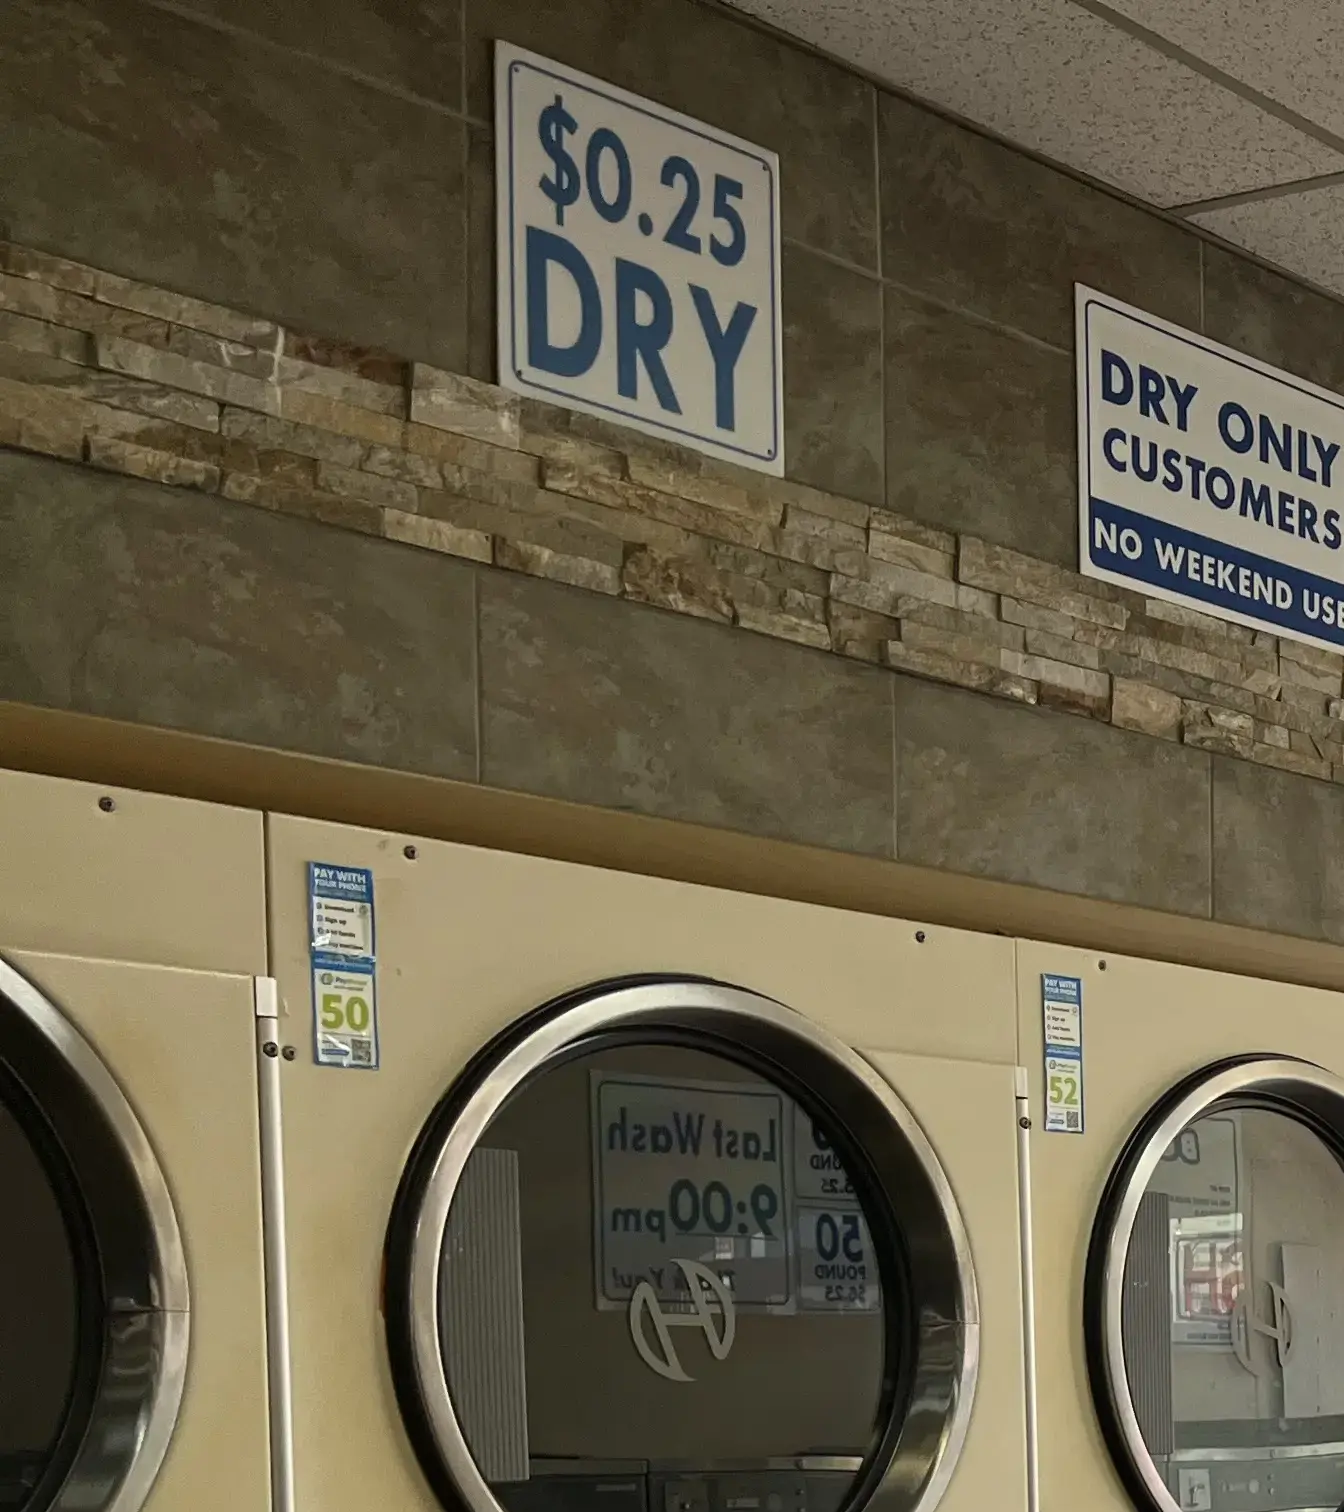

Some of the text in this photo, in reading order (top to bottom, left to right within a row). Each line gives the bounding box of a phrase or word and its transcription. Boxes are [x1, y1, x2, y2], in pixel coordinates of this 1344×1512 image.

[537, 95, 746, 267] $0.25
[525, 225, 758, 432] DRY
[1101, 350, 1341, 488] DRY ONLY
[1102, 427, 1342, 550] CUSTOMERS
[1093, 516, 1143, 560] NO
[1155, 533, 1292, 610] WEEKEND
[314, 868, 366, 884] PAY WITH
[321, 993, 369, 1032] 50
[1050, 1076, 1078, 1105] 52
